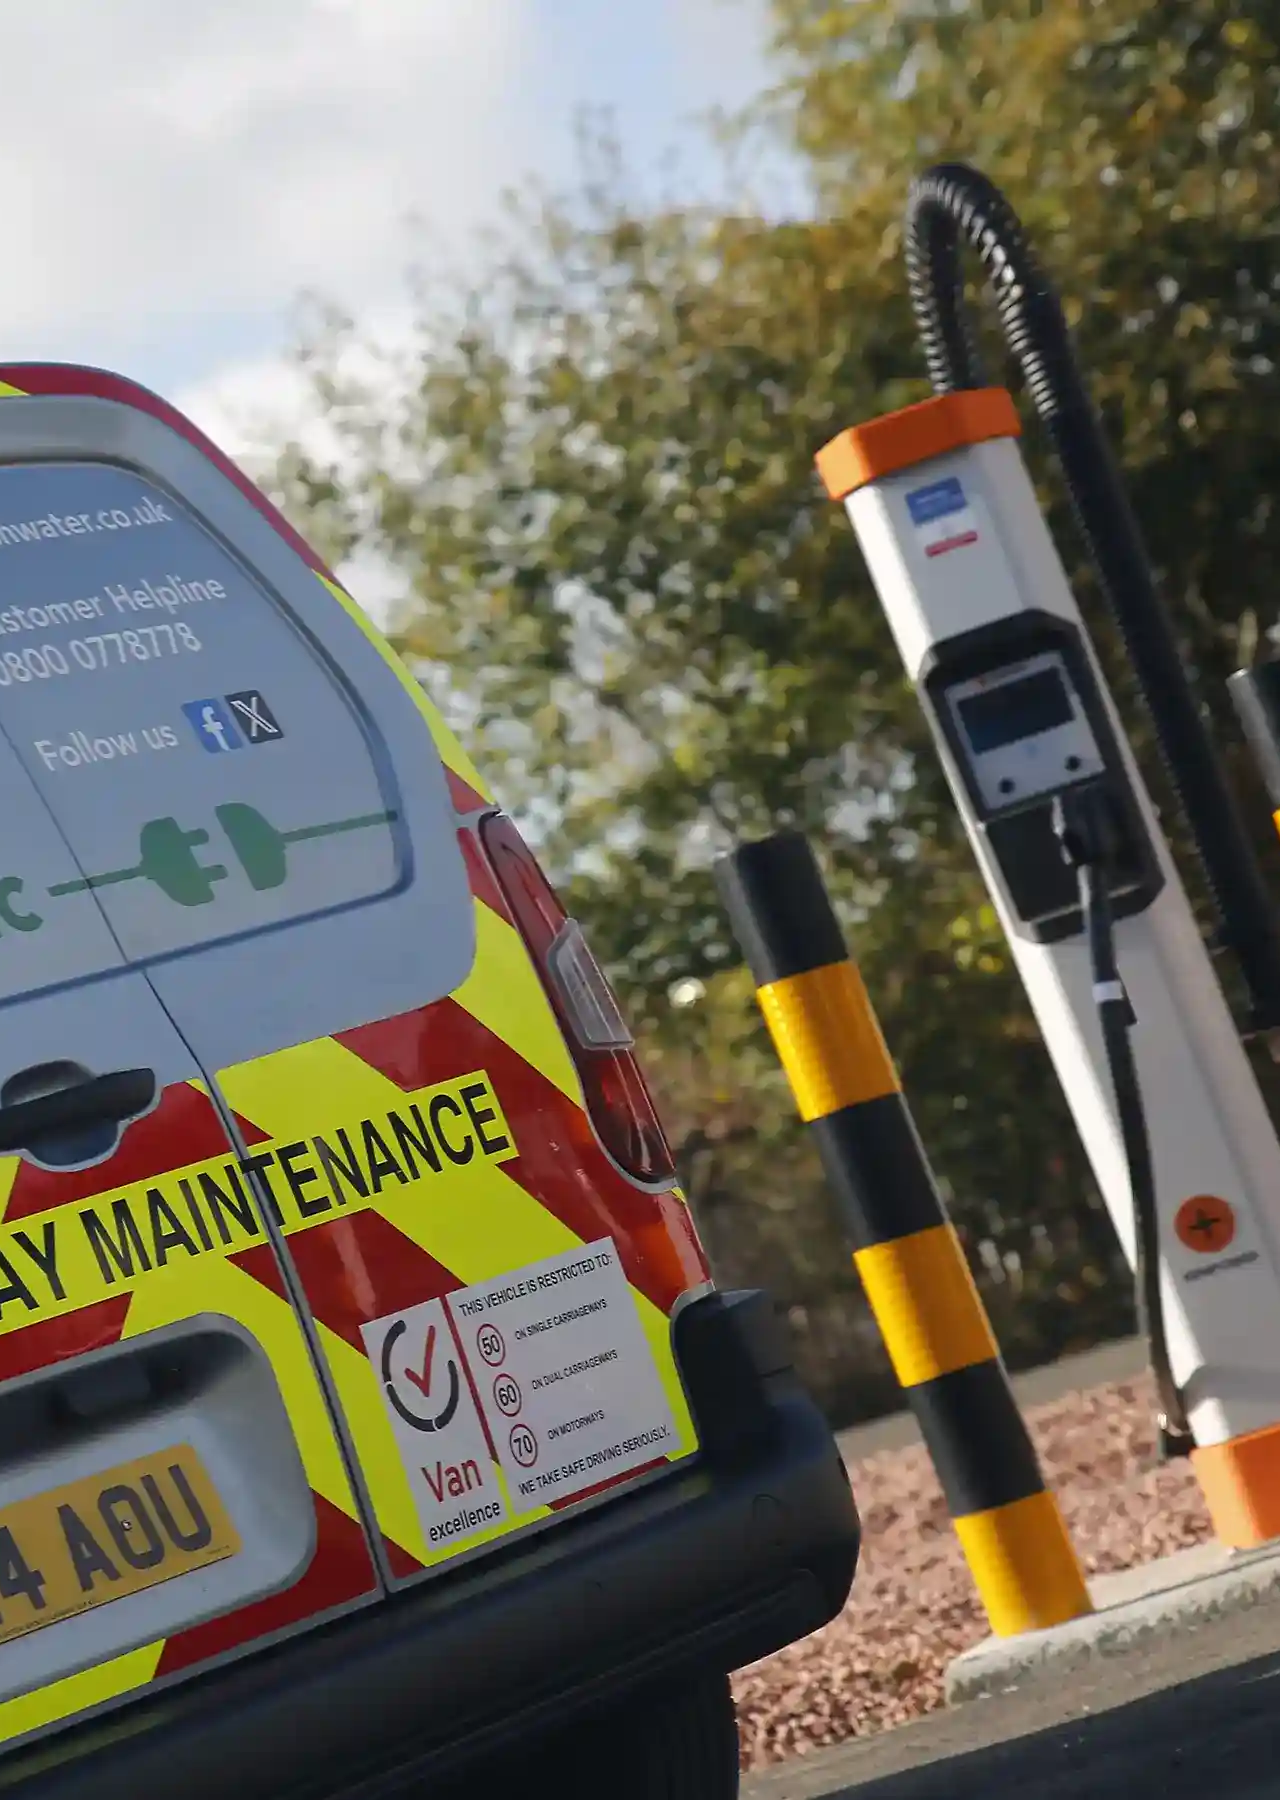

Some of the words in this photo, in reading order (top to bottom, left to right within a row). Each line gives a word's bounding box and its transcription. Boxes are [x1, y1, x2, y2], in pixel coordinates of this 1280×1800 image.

[104, 572, 227, 616] Helpline
[75, 622, 203, 672] 0778778
[34, 727, 137, 771] Follow
[143, 720, 178, 750] us
[81, 1083, 511, 1286] MAINTENANCE
[458, 1299, 485, 1318] THIS
[484, 1282, 527, 1310] VEHICLE
[525, 1278, 538, 1294] IS
[537, 1258, 595, 1290] RESTRICTED
[514, 1329, 527, 1341] ON
[526, 1316, 553, 1337] SINGLE
[552, 1298, 608, 1327] CARRIAGEWAYS
[482, 1334, 500, 1356] 50
[531, 1378, 544, 1391] ON
[543, 1371, 564, 1386] DUAL
[562, 1349, 619, 1379] CARRIAGEWAYS
[498, 1384, 517, 1406] 60
[514, 1435, 533, 1457] 70
[547, 1428, 560, 1441] ON
[559, 1409, 605, 1436] MOTORWAYS
[421, 1459, 484, 1504] Van
[518, 1480, 536, 1496] WE
[536, 1467, 562, 1488] TAKE
[561, 1458, 587, 1480] SAFE
[586, 1444, 624, 1470] DRIVING
[57, 1464, 212, 1592] AOU
[428, 1501, 502, 1543] excellence
